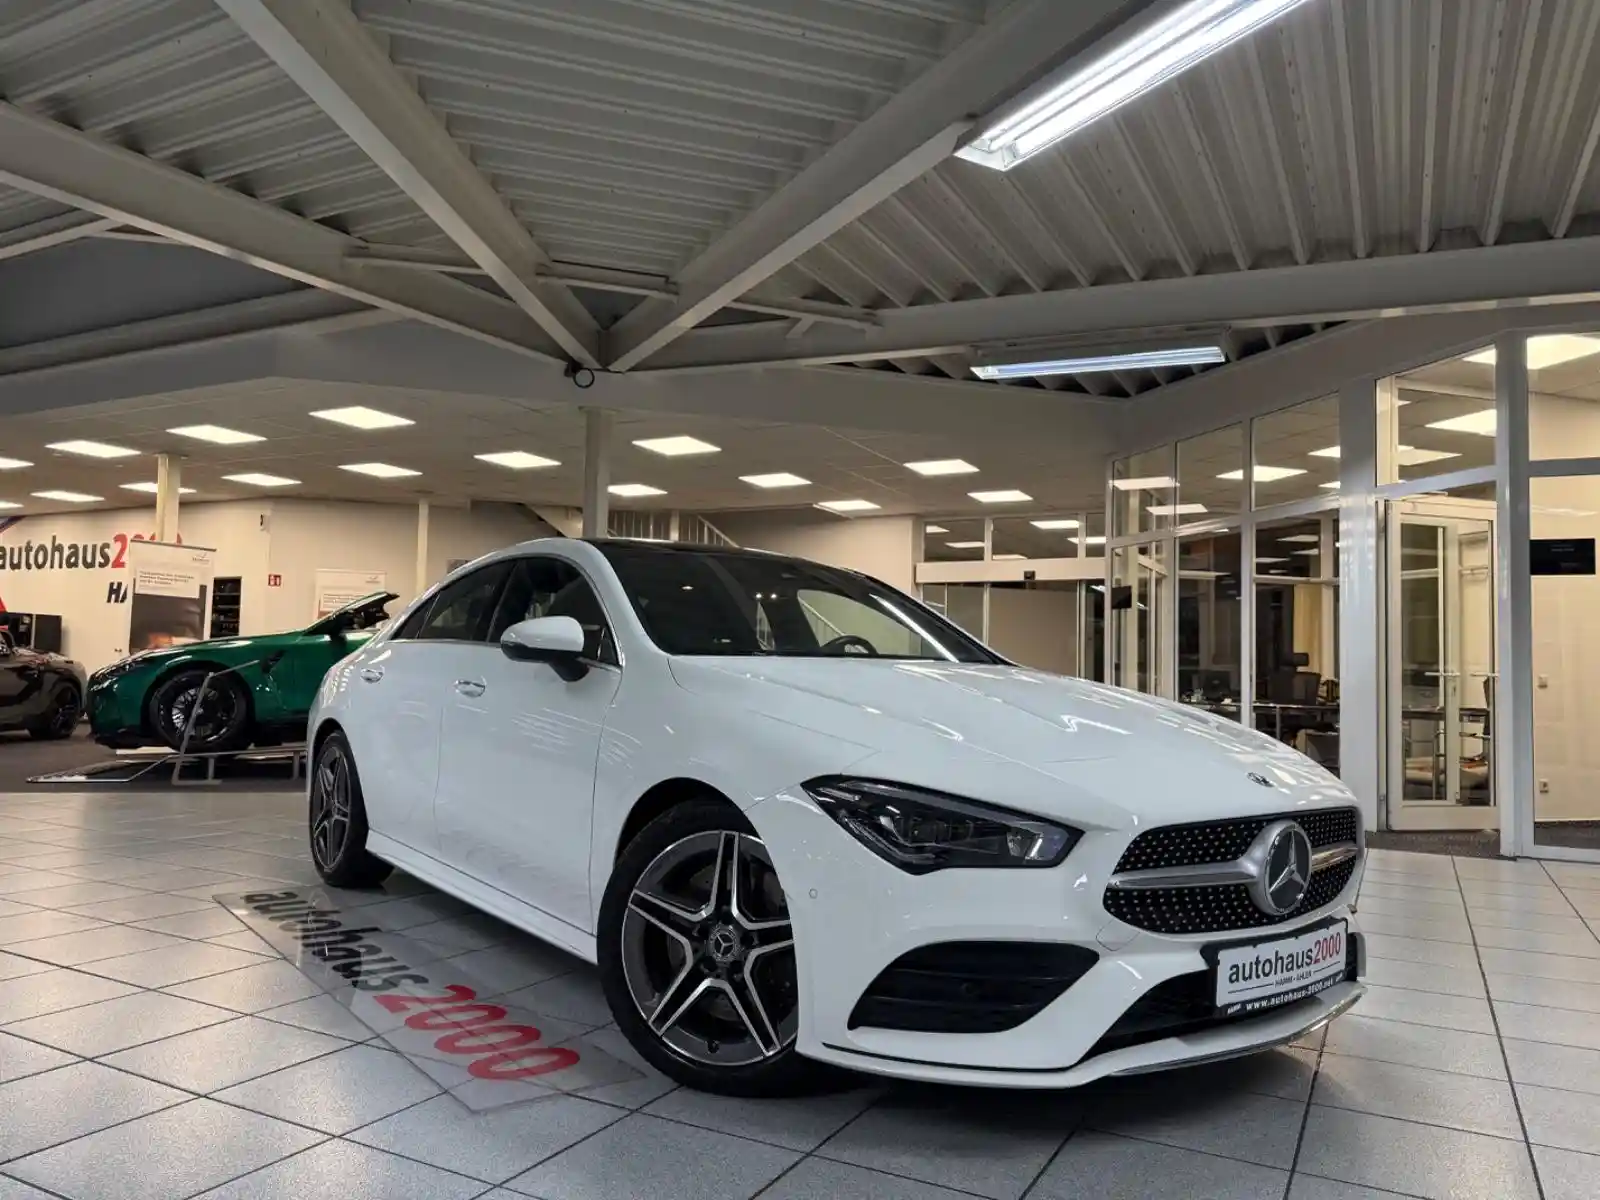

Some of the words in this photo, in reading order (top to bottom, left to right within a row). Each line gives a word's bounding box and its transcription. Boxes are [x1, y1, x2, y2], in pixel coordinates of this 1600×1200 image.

[0, 533, 183, 571] autohaus2
[1228, 931, 1342, 984] autohaus2000
[243, 891, 581, 1081] autohaus2000
